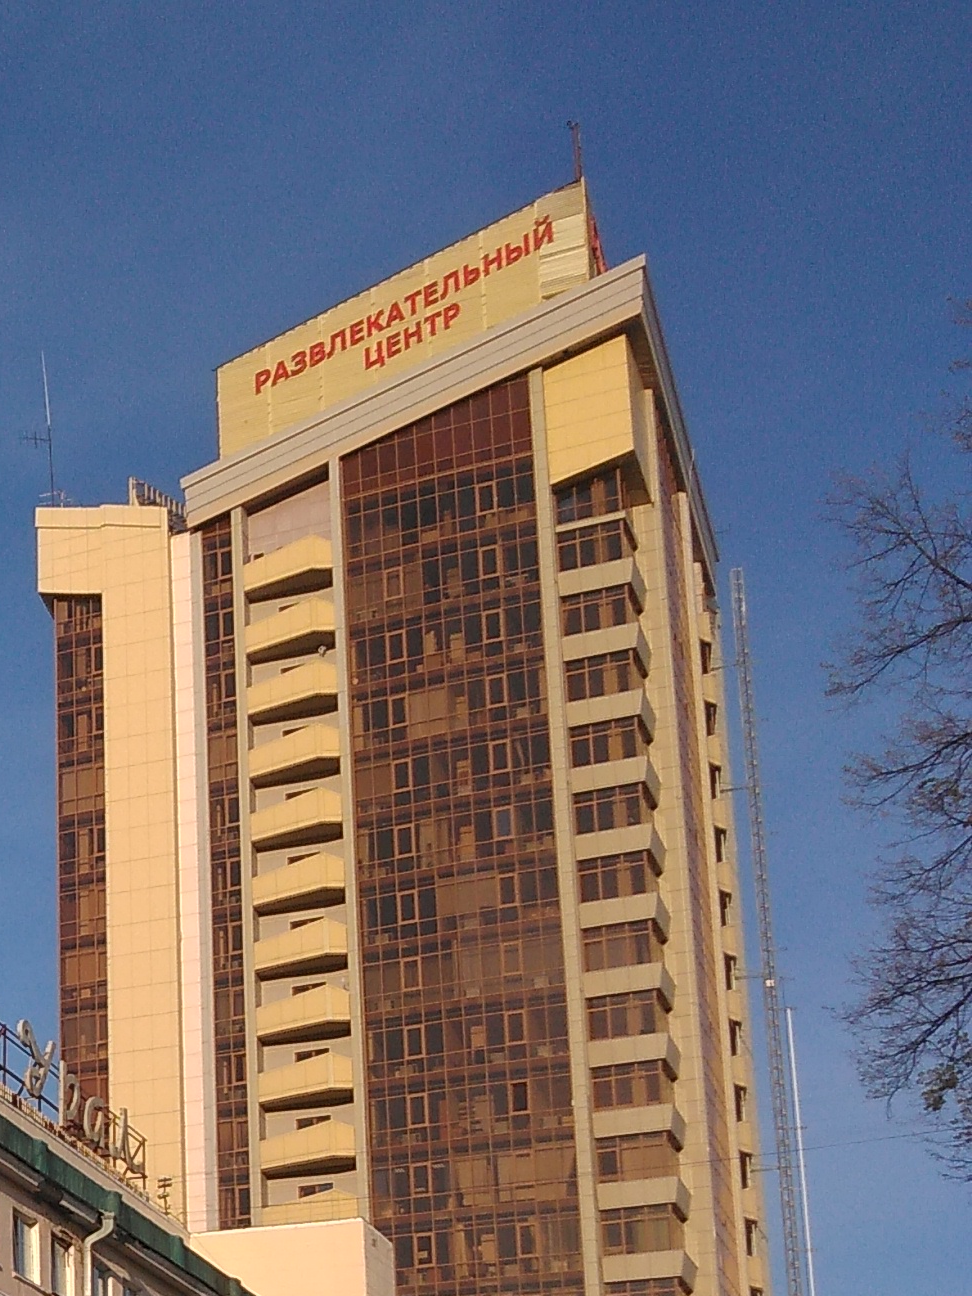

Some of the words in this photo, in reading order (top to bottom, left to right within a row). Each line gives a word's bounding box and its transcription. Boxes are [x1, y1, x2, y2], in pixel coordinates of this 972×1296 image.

[254, 215, 555, 396] РАЗВЛЕКАТЕЛЬНЫЙ
[363, 302, 461, 371] ЦЕНТР
[16, 1018, 145, 1174] Урал
